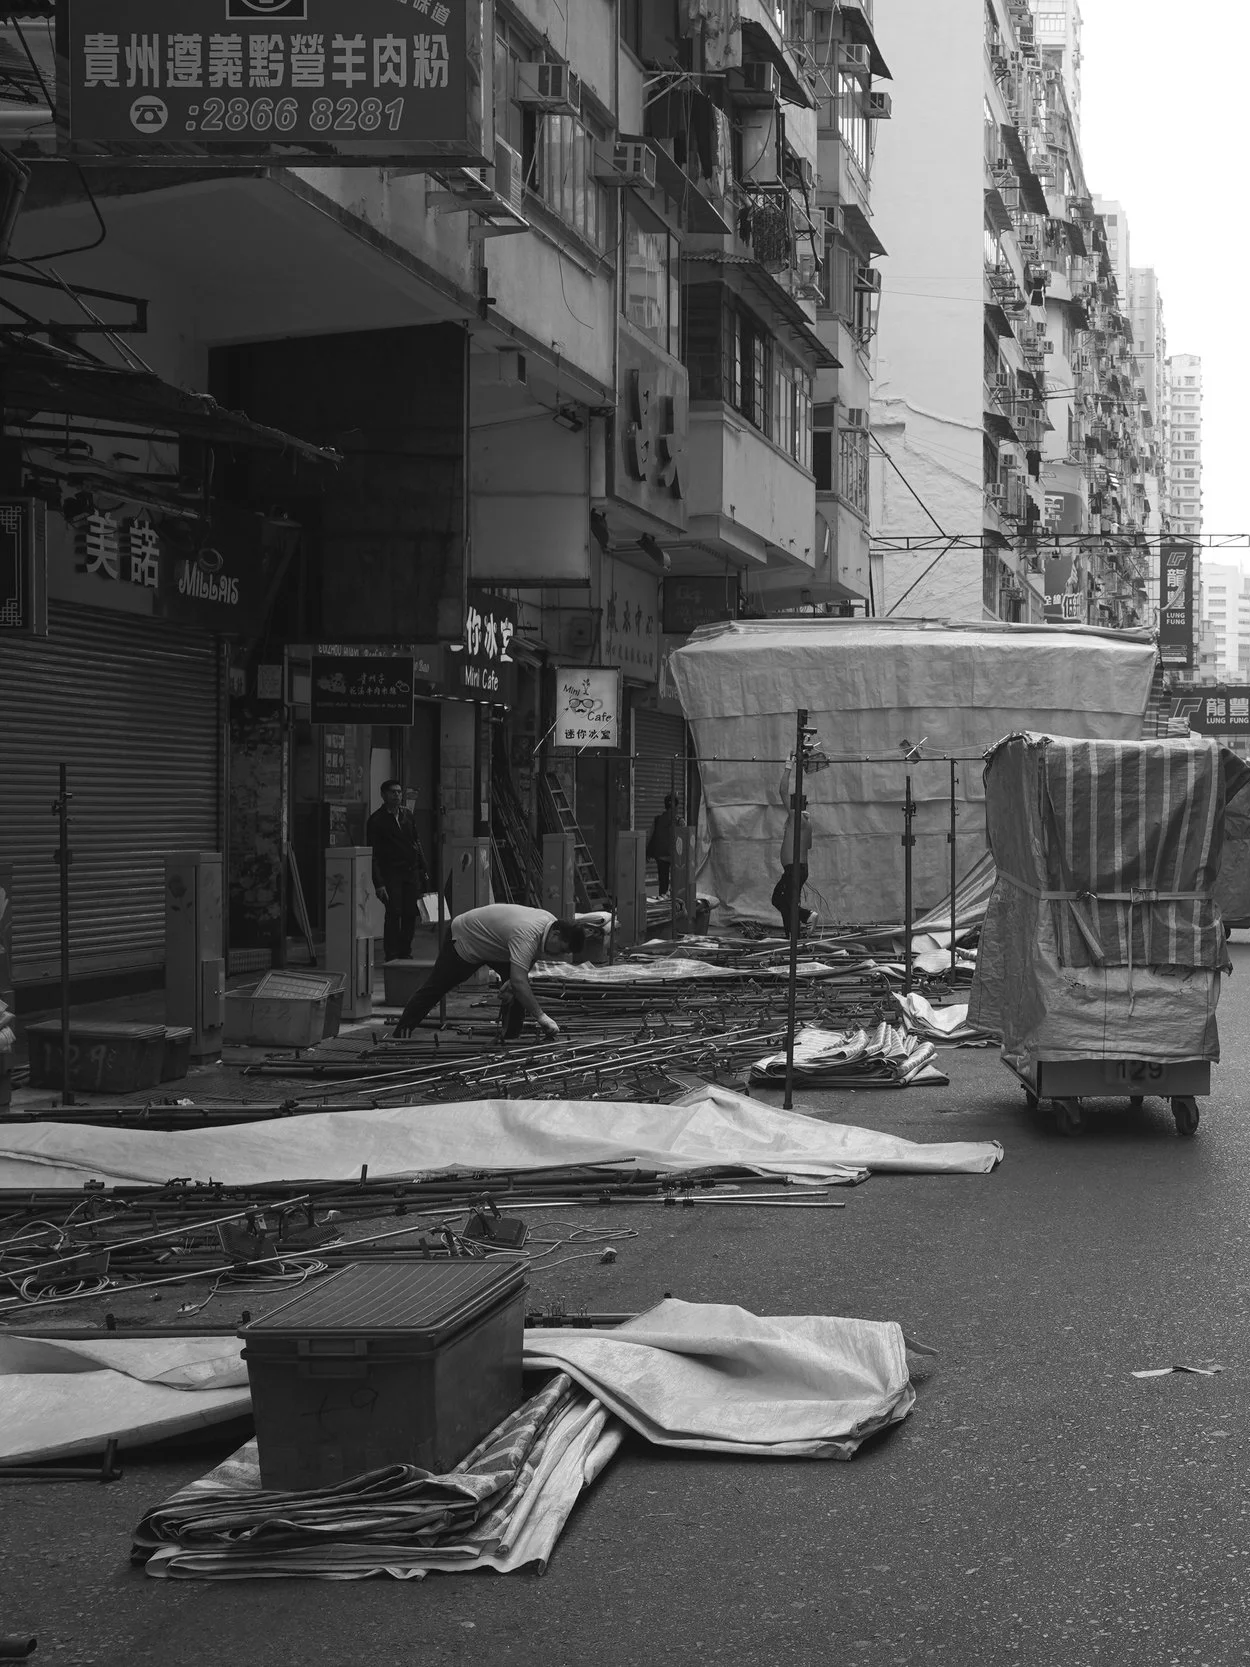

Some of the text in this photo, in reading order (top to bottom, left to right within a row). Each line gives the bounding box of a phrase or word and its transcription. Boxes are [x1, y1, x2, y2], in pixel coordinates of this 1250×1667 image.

[396, 0, 451, 28] 味道
[83, 32, 450, 89] 貴州遵義黔營羊肉粉
[309, 97, 405, 131] 8281
[1166, 568, 1186, 609] 龍豐
[482, 668, 499, 692] Cafe
[563, 684, 581, 697] Mini
[587, 711, 613, 723] Cafe
[1206, 698, 1249, 717] 龍豐
[564, 728, 612, 740] 迷你冰室
